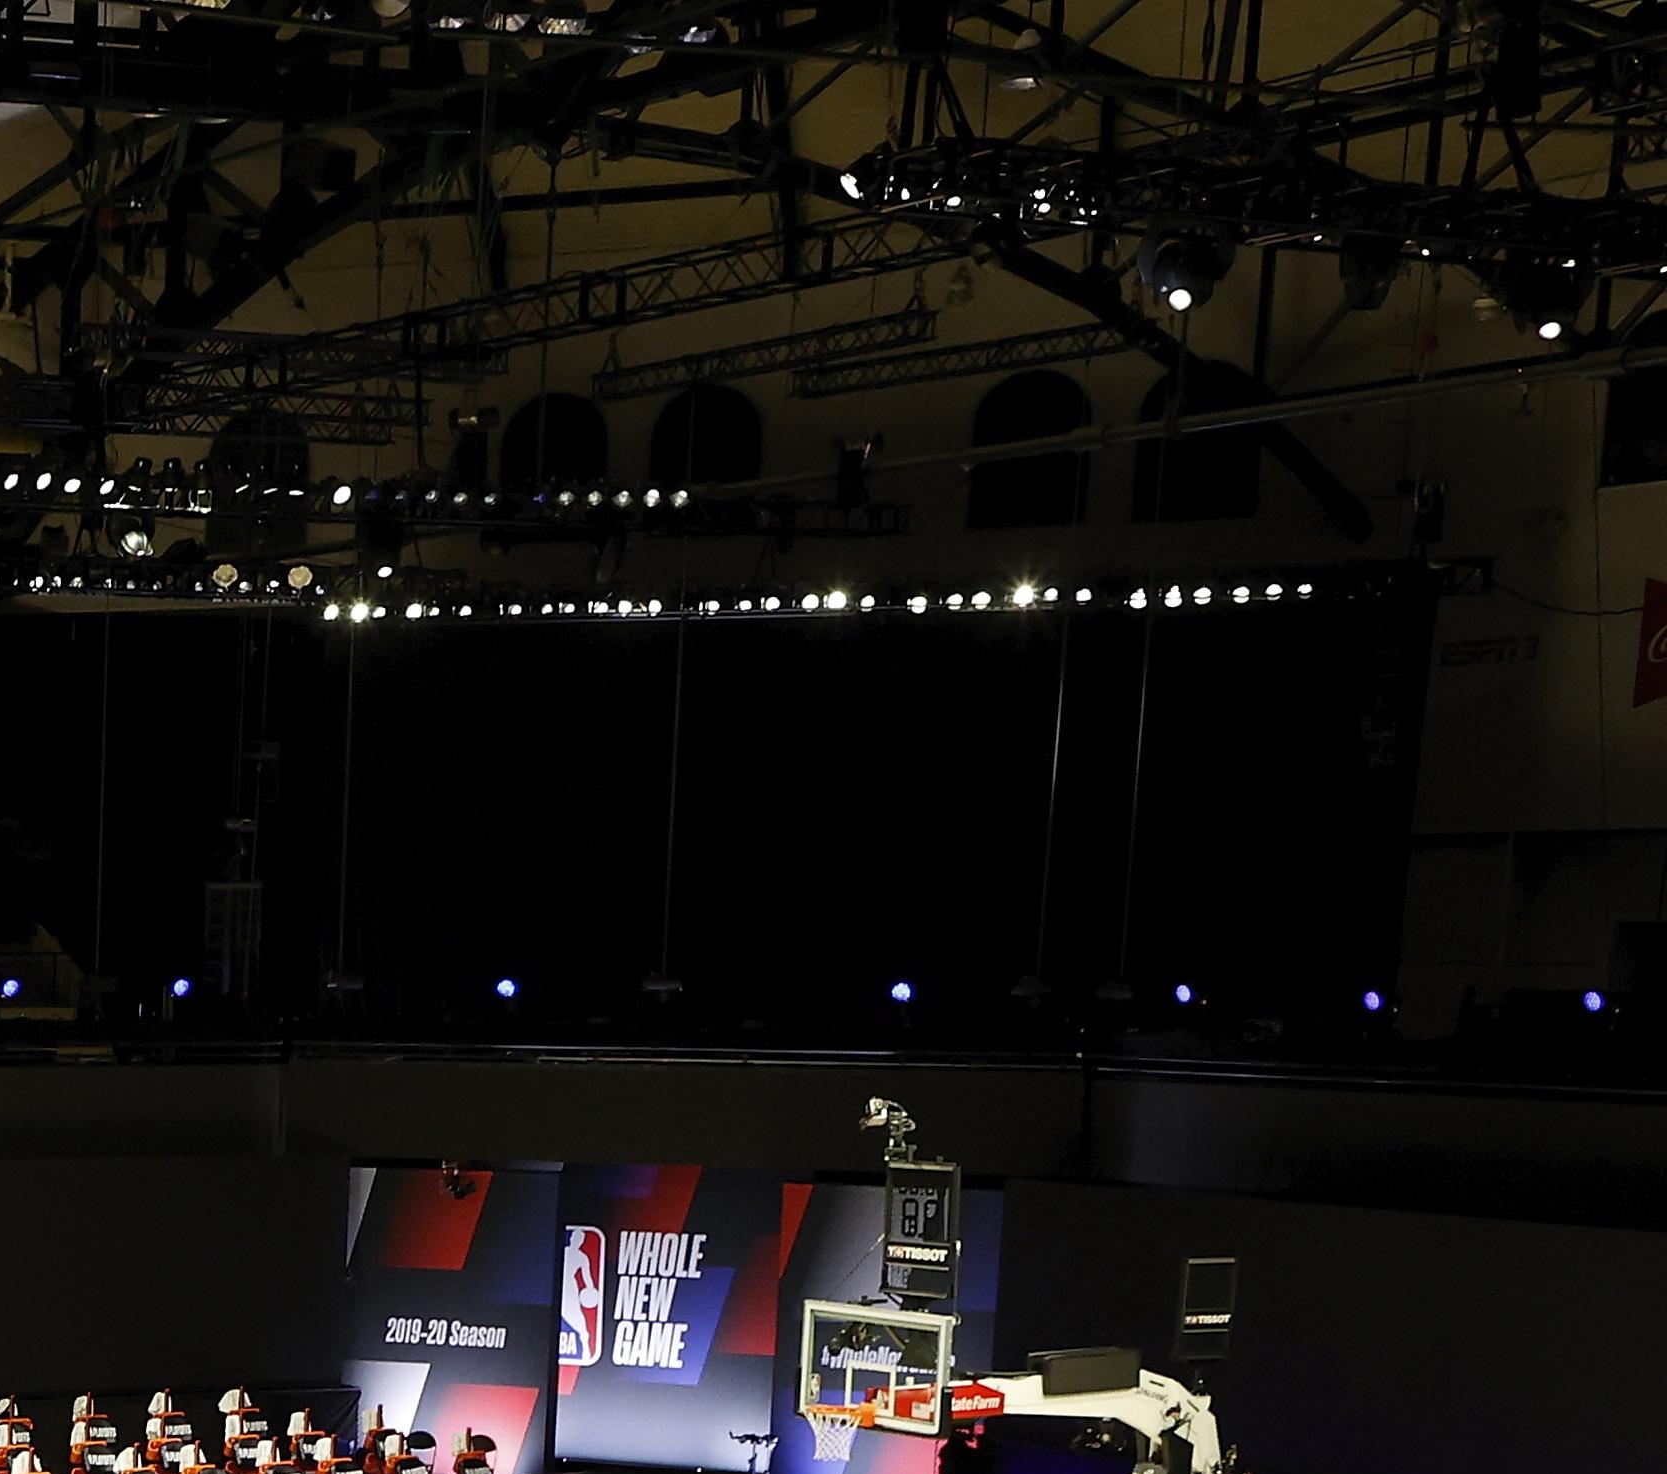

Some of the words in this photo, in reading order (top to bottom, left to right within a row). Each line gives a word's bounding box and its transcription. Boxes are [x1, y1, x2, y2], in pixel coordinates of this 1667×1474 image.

[617, 1230, 707, 1279] WHOLE
[614, 1276, 677, 1322] NEW
[385, 1317, 447, 1345] 2019-20
[449, 1319, 506, 1349] Season
[558, 1332, 578, 1356] BA
[611, 1320, 688, 1369] GAME
[951, 1395, 1001, 1412] tateFarm
